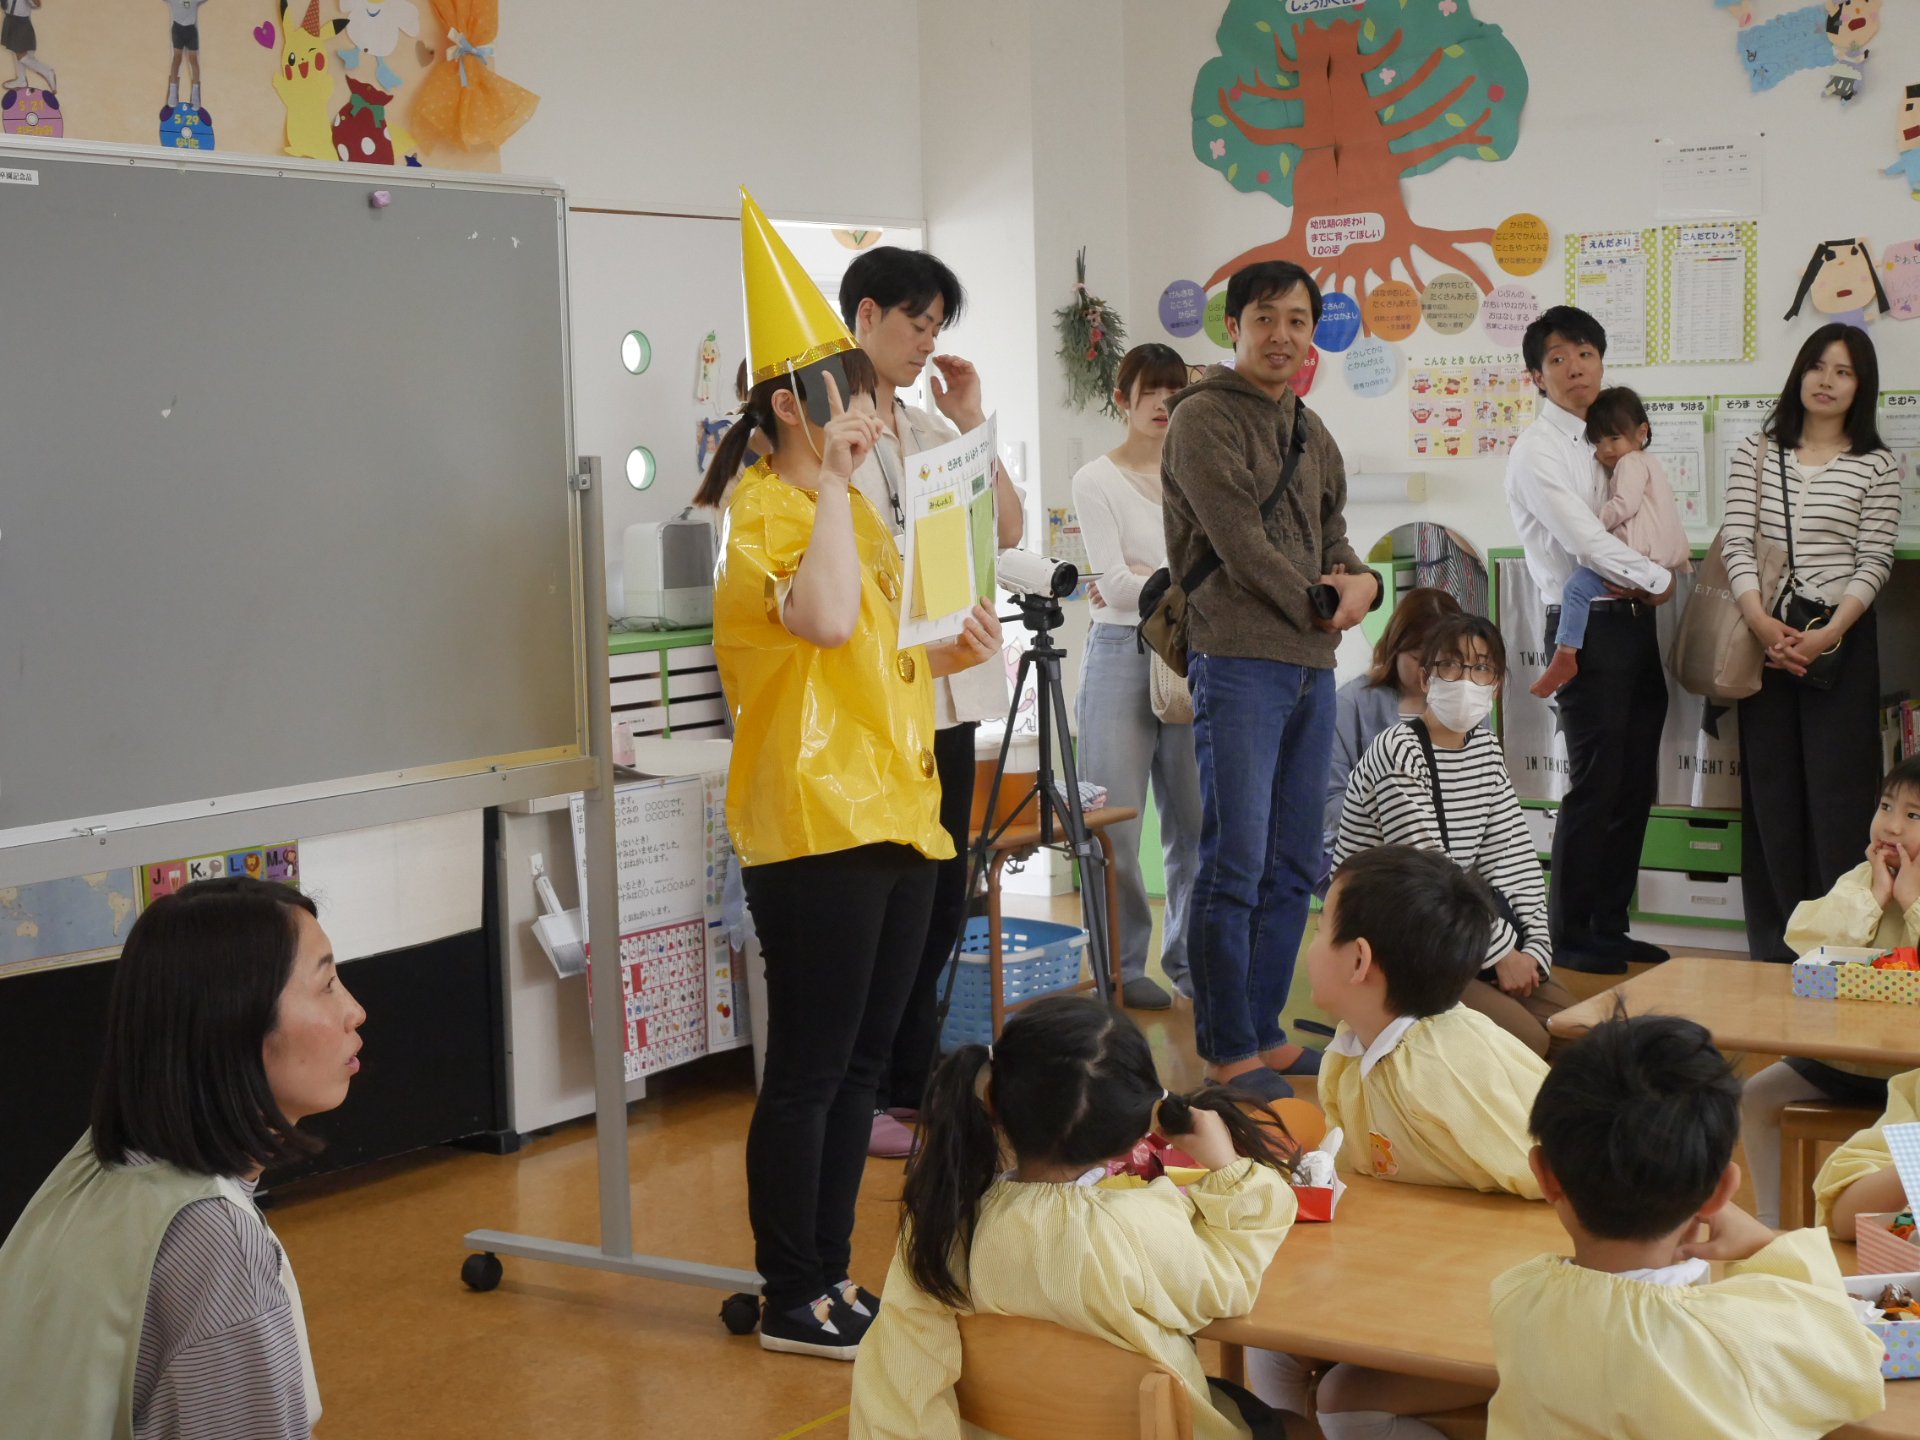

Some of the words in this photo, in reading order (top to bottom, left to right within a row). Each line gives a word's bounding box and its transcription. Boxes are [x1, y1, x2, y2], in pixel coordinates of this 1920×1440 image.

[1310, 217, 1366, 230] 幼児期の終わり
[1311, 229, 1381, 243] までに育ってほしい
[1589, 238, 1631, 250] えんだより
[1424, 356, 1447, 367] こんな
[1451, 356, 1465, 366] とき
[1469, 355, 1493, 365] なんて
[1680, 401, 1705, 412] ちはる
[1726, 399, 1751, 410] そうま
[1888, 396, 1917, 406] きむら
[1519, 651, 1546, 667] TWIN
[1525, 756, 1538, 770] IN
[1678, 755, 1690, 770] IN
[229, 857, 241, 873] L
[266, 850, 278, 868] M
[152, 868, 162, 885] J
[190, 862, 203, 880] K
